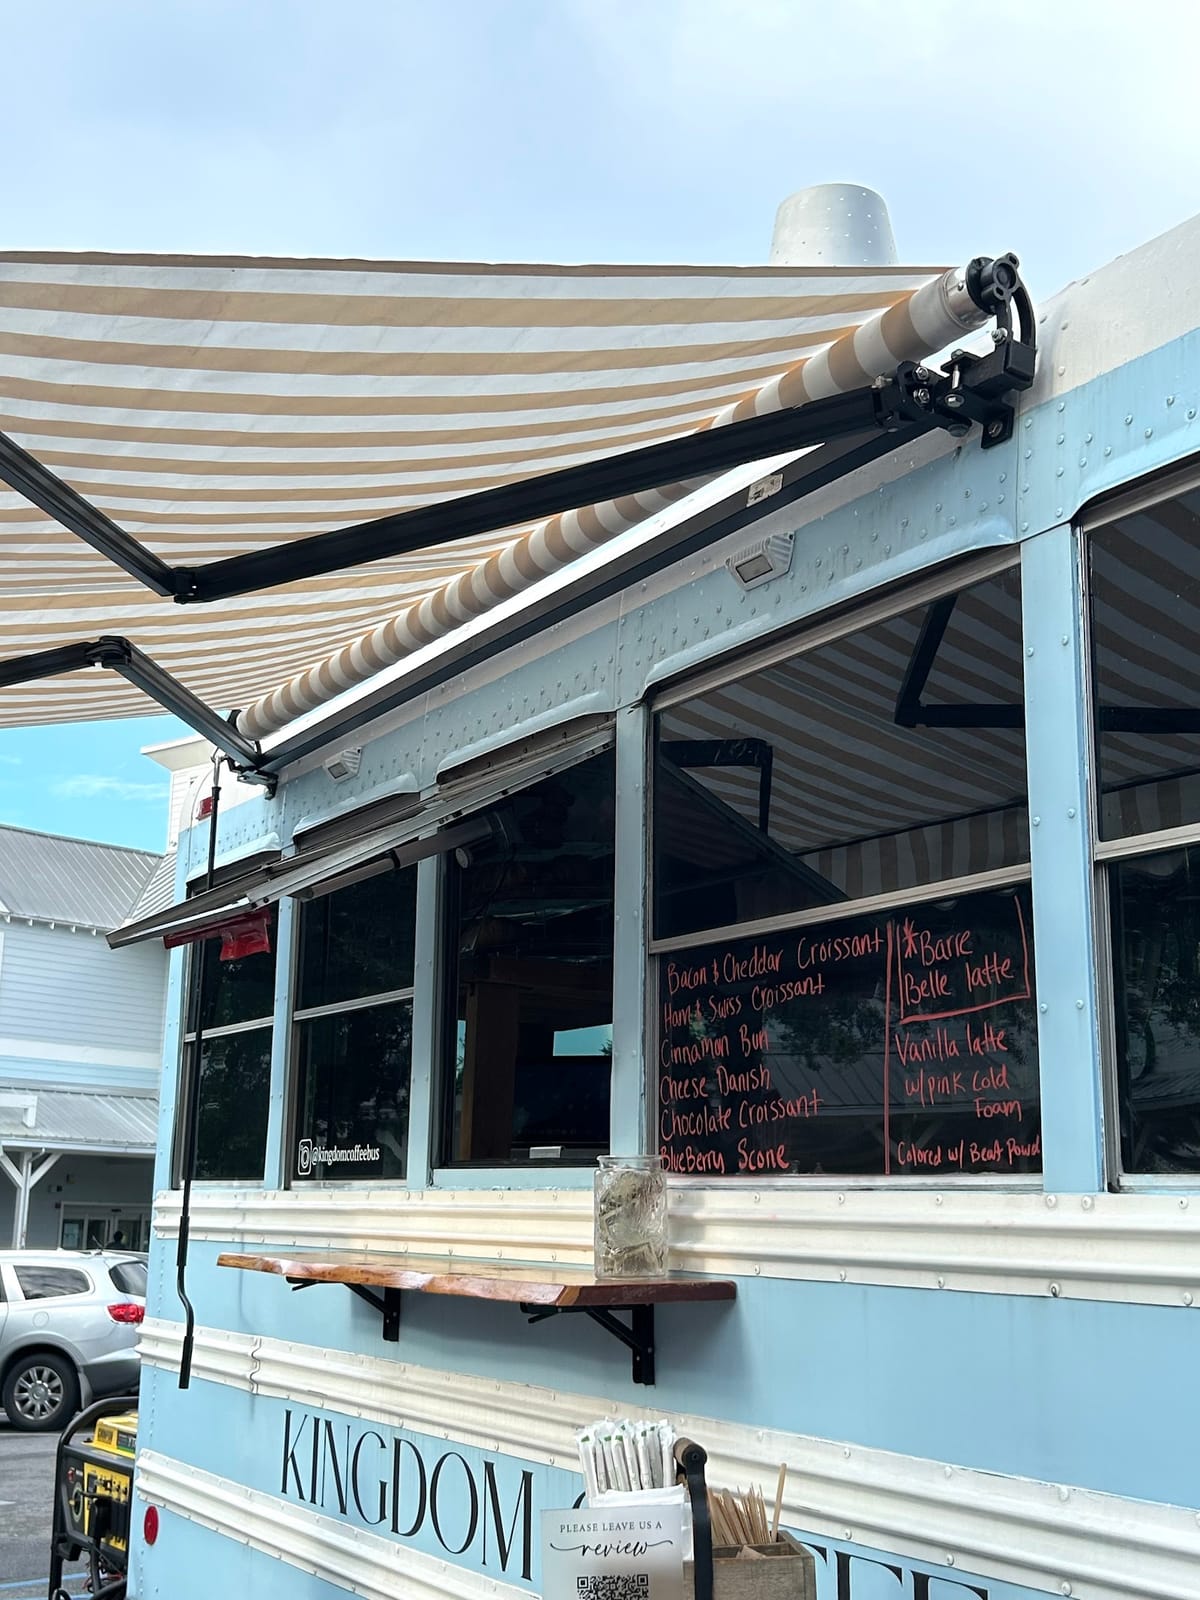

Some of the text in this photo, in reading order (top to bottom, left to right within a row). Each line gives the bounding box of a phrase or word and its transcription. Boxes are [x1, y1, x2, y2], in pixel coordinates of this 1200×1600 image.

[667, 962, 707, 995] Bacon
[724, 944, 784, 984] Cheddar
[798, 927, 885, 970] Croissant
[904, 952, 1014, 1006] Belle latte
[665, 1002, 691, 1033] Ham
[708, 995, 742, 1023] Swiss
[751, 973, 826, 1012] Croissant
[661, 1024, 769, 1068] Cinnamon Bun
[895, 1022, 1008, 1067] Vanilla latte
[660, 1063, 771, 1105] Cheese Danish
[660, 1087, 824, 1142] Chocolate Croissant
[974, 1097, 1022, 1122] Foam
[311, 1144, 380, 1166] @kingdomcoffeebus
[737, 1137, 790, 1171] Scone
[897, 1141, 942, 1166] Colored
[281, 1409, 533, 1581] KINGDOM
[560, 1520, 662, 1533] PLEASE LEAVE US A
[550, 1540, 673, 1557] review
